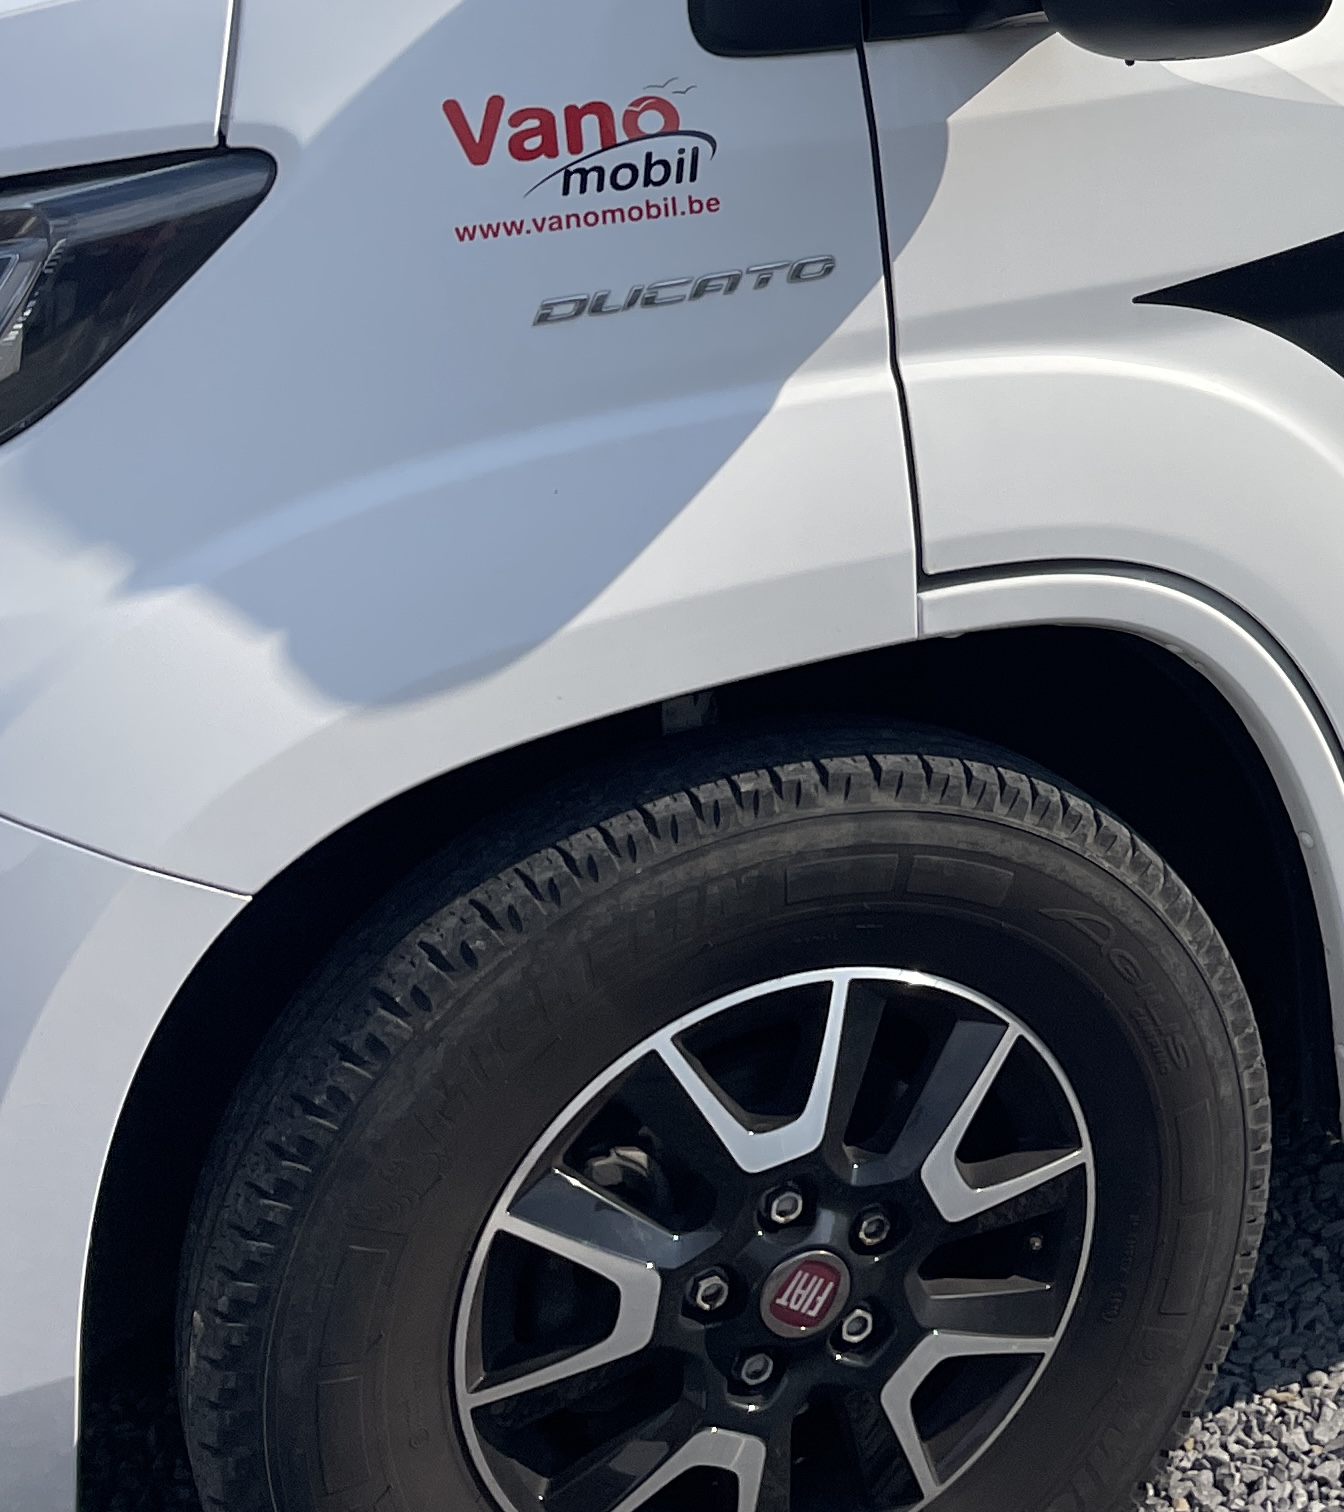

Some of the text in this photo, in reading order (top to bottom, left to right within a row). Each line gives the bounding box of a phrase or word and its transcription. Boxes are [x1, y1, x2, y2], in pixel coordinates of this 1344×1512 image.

[442, 94, 681, 167] Vano
[561, 146, 699, 197] mobil
[454, 194, 721, 243] www.vanomobil.be
[531, 254, 836, 328] DUCATO
[775, 1270, 835, 1318] FIAT
